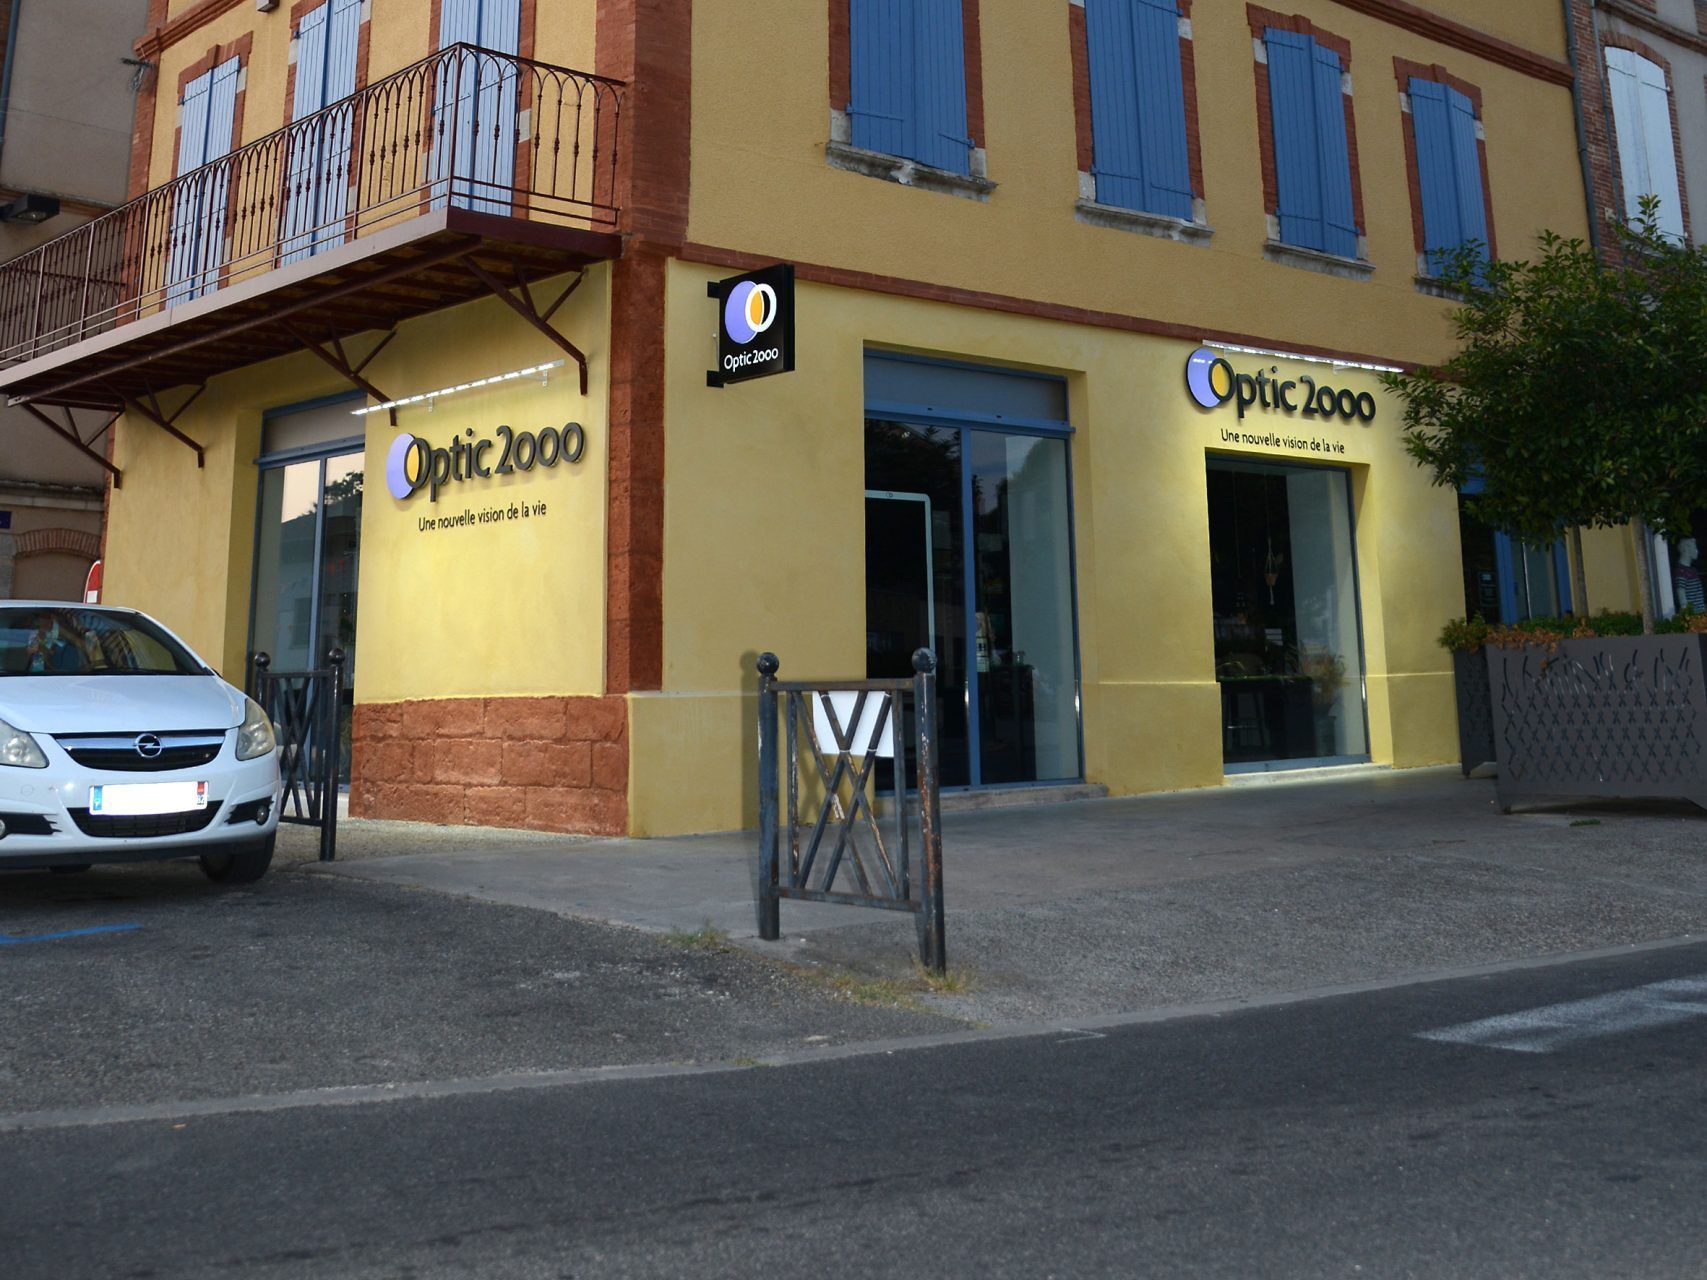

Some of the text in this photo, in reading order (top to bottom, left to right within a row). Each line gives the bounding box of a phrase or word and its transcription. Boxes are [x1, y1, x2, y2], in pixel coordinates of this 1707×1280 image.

[1220, 428, 1345, 454] Une nouvelle vision de la vie
[418, 500, 547, 532] Une nouvelle vision de la vie
